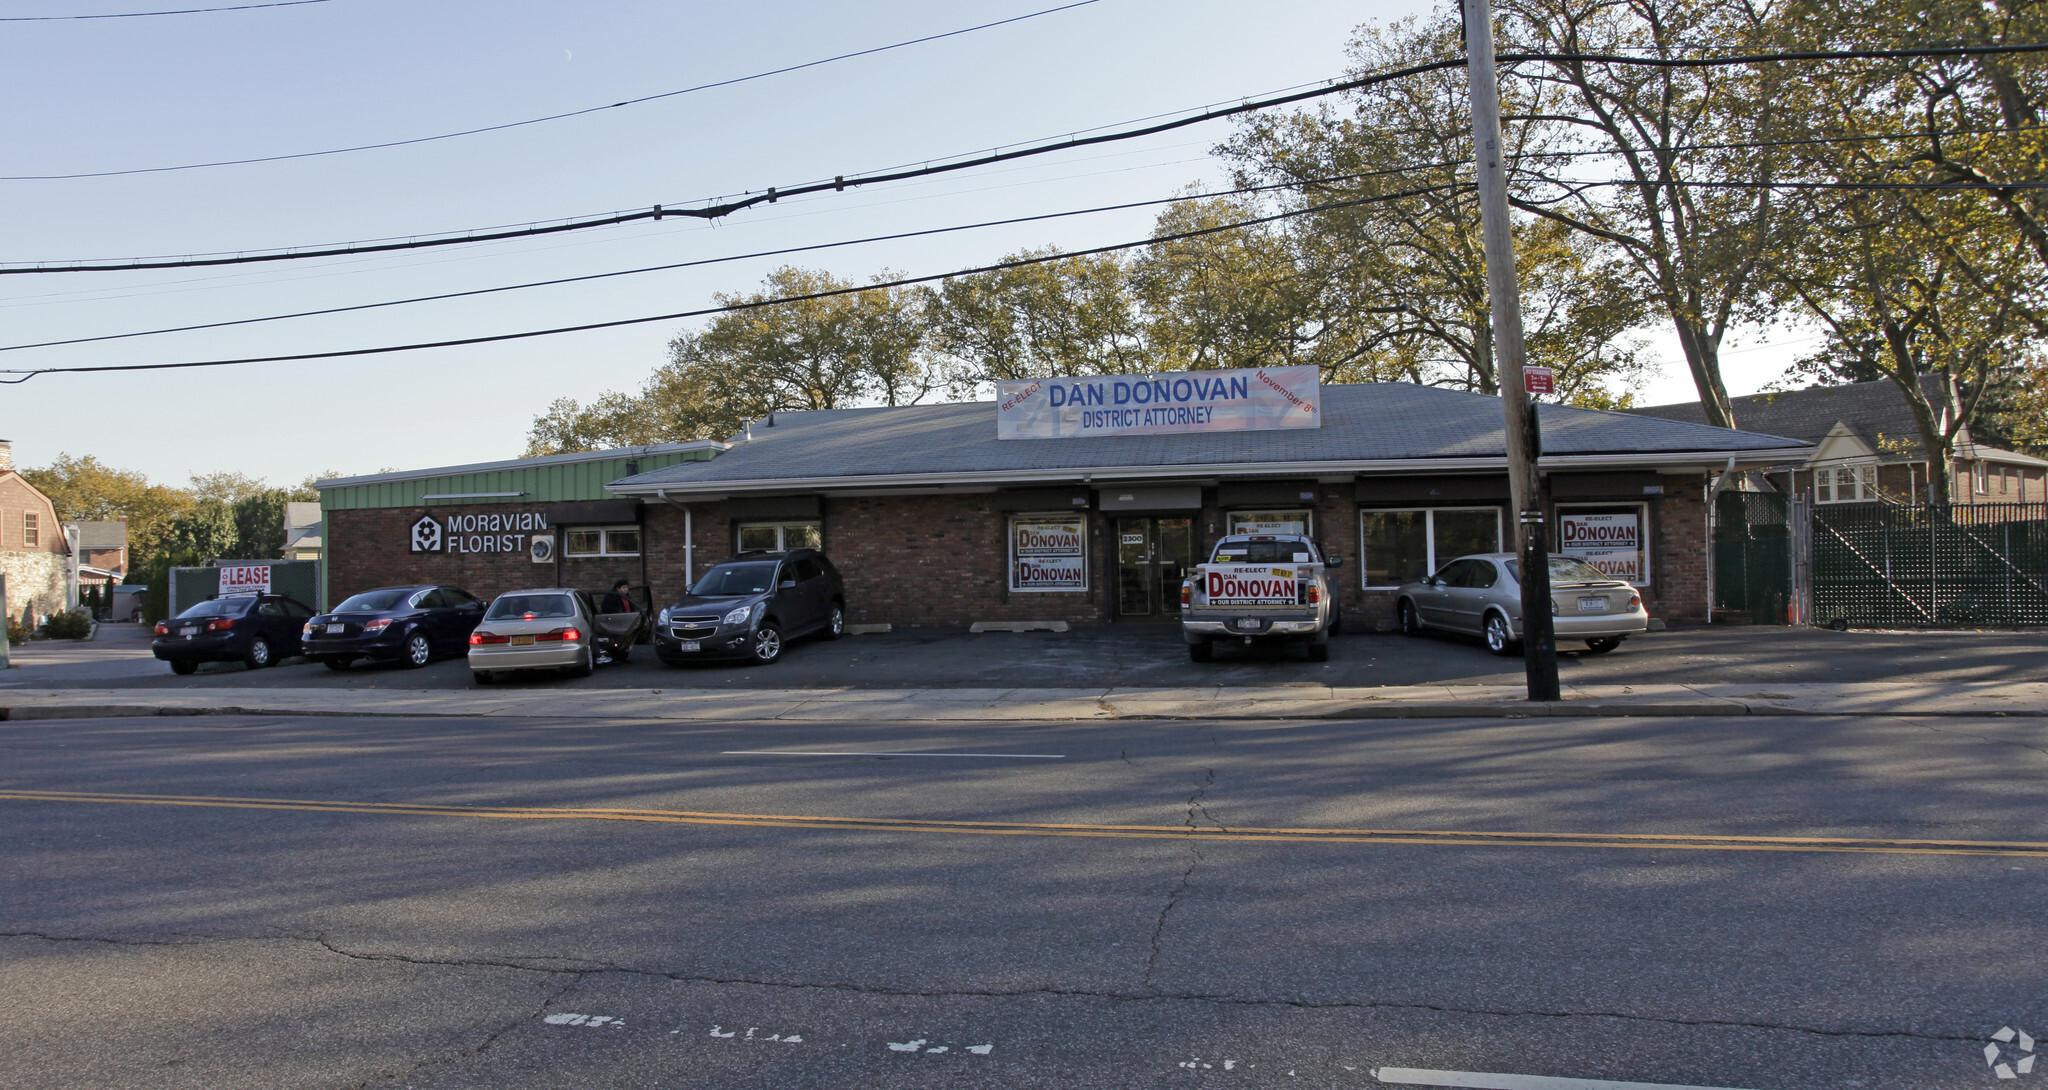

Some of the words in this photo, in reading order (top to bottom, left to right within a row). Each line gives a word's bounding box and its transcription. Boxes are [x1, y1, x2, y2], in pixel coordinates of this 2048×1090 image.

[1001, 381, 1042, 412] RE-ELECT
[1050, 383, 1104, 407] DAN
[1114, 376, 1248, 405] DONOVAN
[1255, 369, 1303, 407] November
[1303, 403, 1318, 414] 8th
[1083, 409, 1141, 428] DISTRICT
[1144, 406, 1213, 426] ATTORNEY
[1019, 529, 1079, 548] DONOVAN
[1563, 520, 1635, 541] DONOVAN
[448, 534, 525, 553] FLORIST
[230, 567, 269, 585] LEASE
[1020, 562, 1081, 581] DONOVAN
[1208, 572, 1295, 597] DONOVAN
